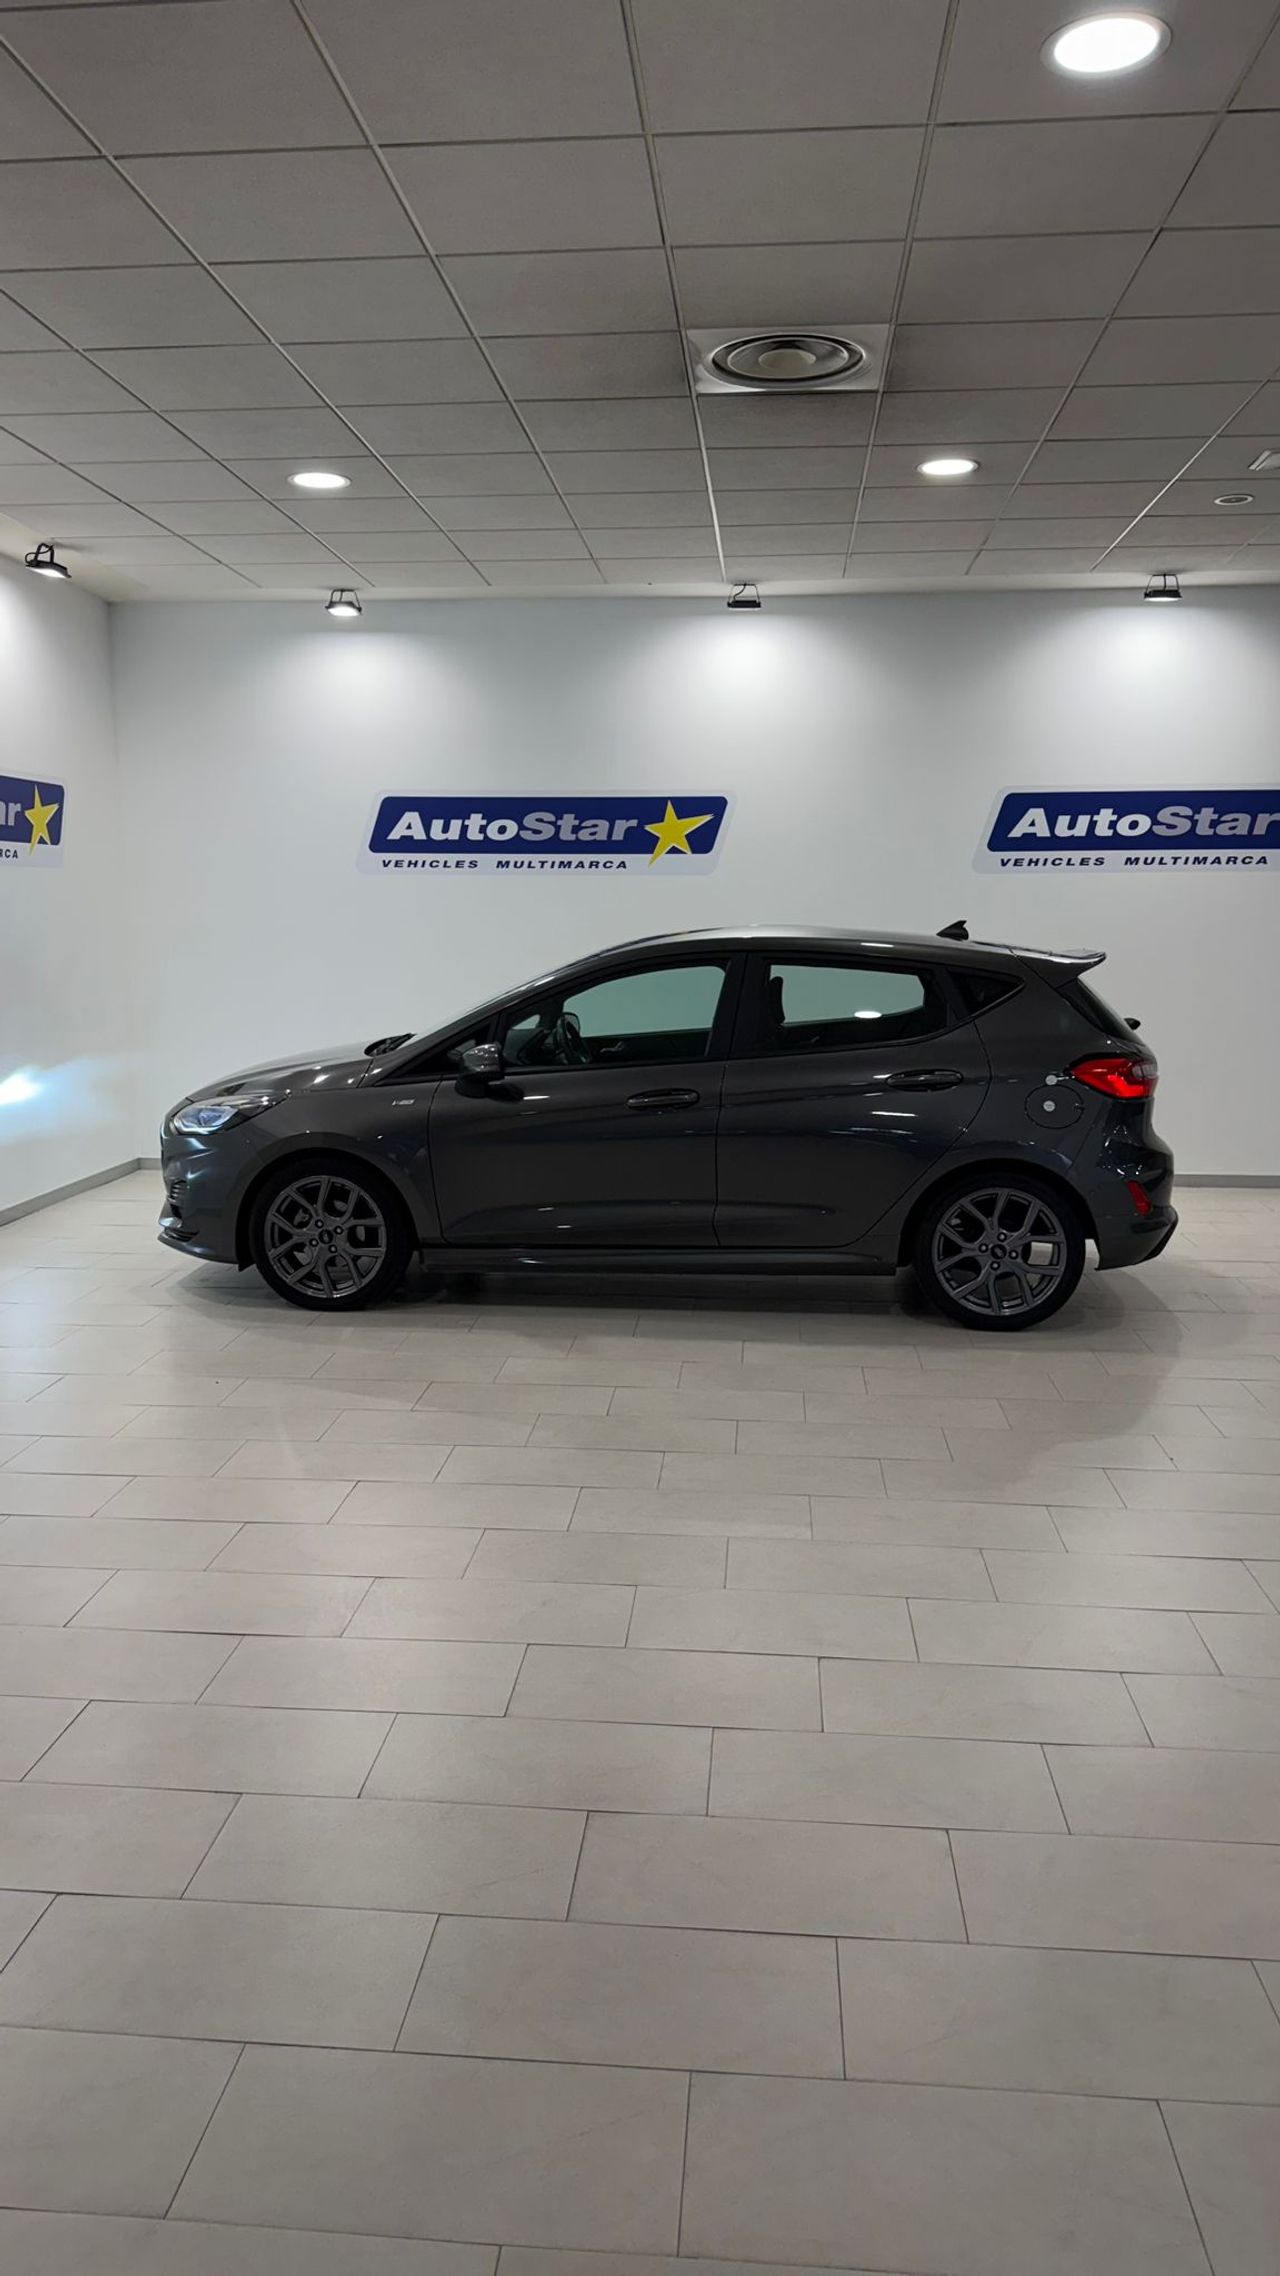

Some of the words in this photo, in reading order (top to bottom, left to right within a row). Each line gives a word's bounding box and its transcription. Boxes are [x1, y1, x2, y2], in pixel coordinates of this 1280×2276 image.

[386, 811, 638, 841] AutoStar
[1007, 805, 1280, 838] AutoStar
[382, 859, 479, 869] VEHICLES
[496, 859, 628, 869] MULTIMARCA
[1000, 857, 1105, 867] VEHICLES
[1124, 856, 1268, 866] MULTIMARCA
